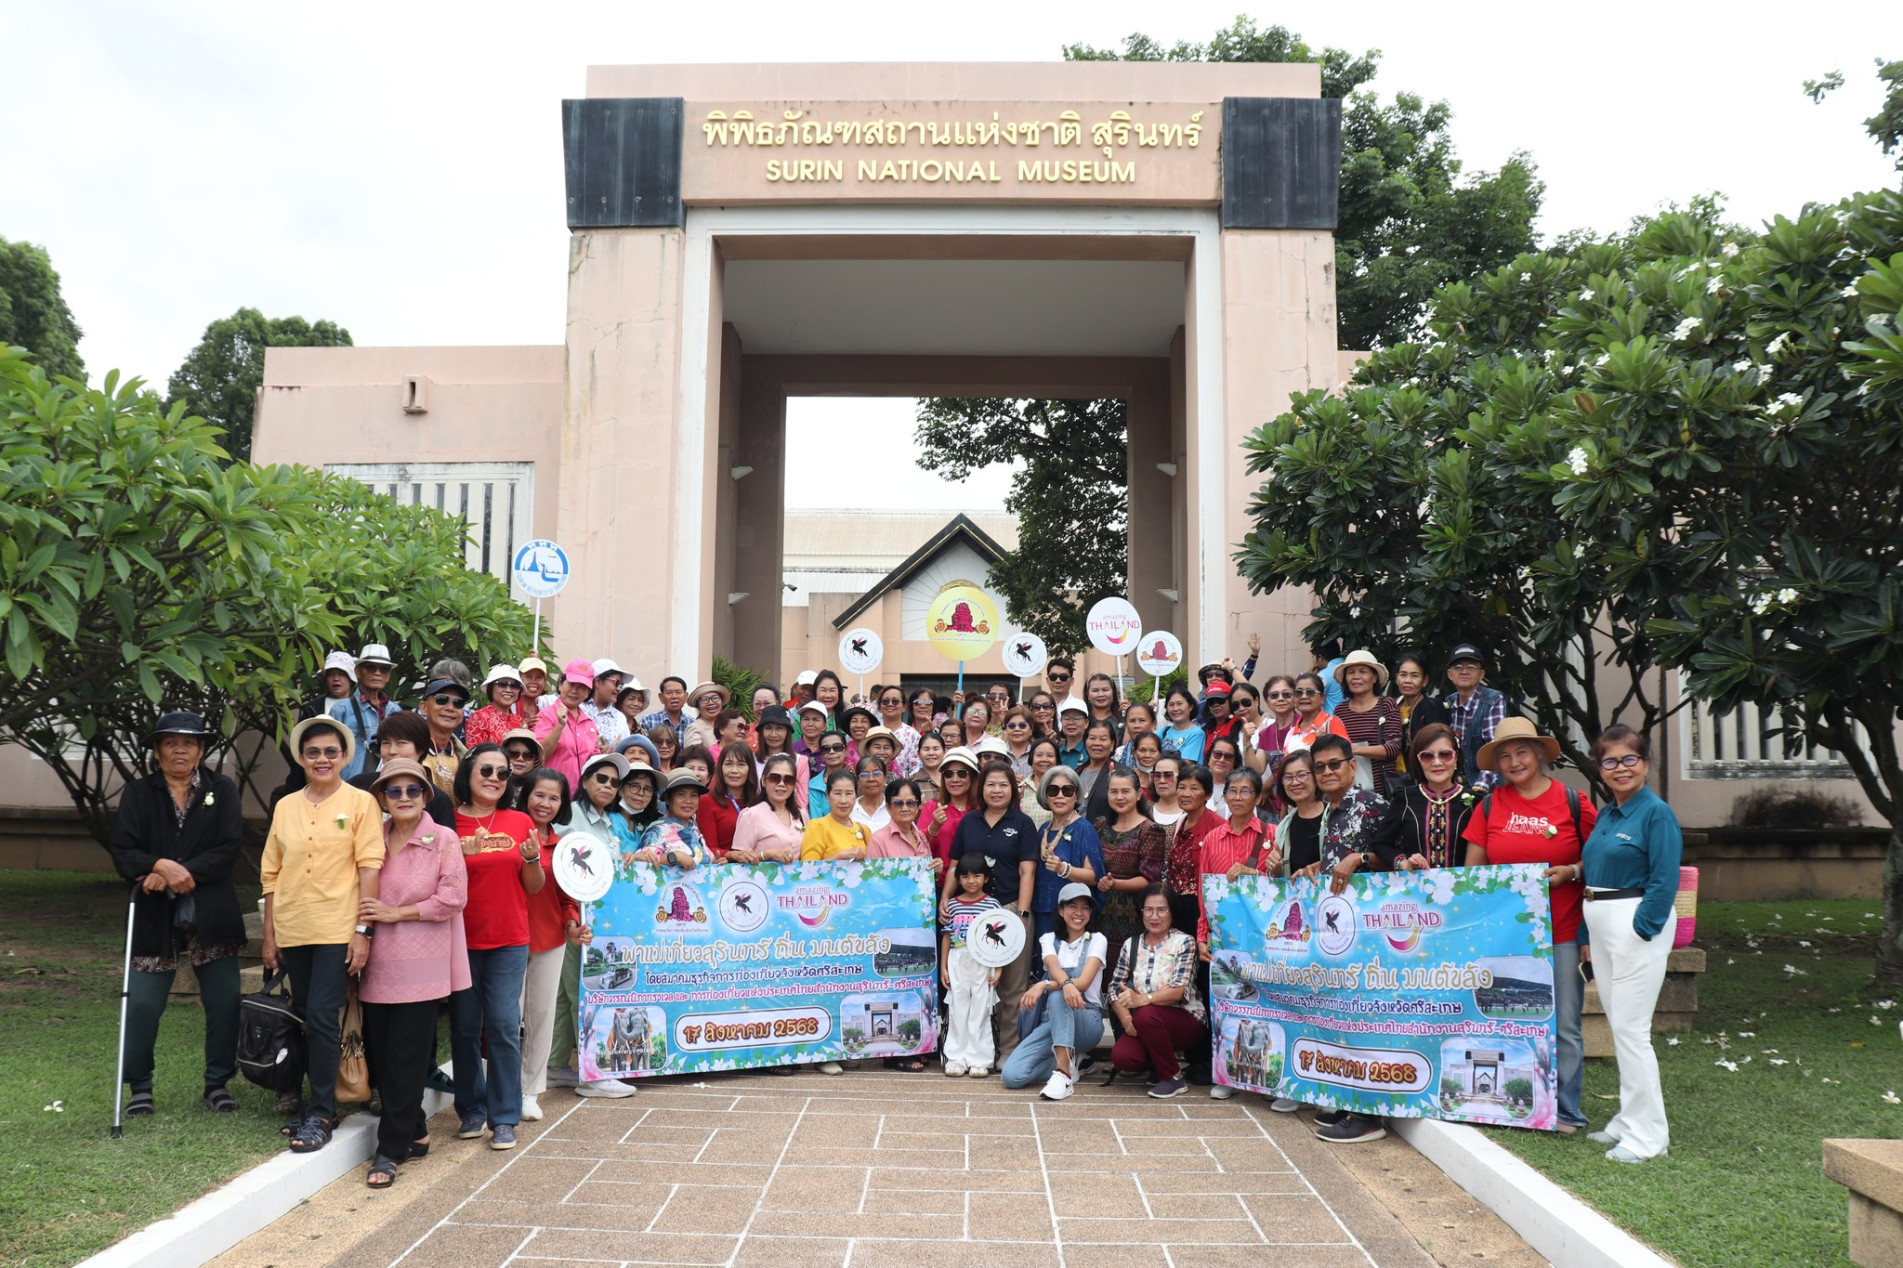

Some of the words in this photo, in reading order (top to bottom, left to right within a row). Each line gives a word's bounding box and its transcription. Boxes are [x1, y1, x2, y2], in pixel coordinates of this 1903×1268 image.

[702, 110, 1081, 147] พิพิธภัณฑสถานแห่งชาติ
[1092, 110, 1203, 158] สุรินทร์
[765, 160, 844, 182] SURIN
[857, 160, 1002, 182] NATIONAL
[1018, 160, 1137, 182] MUSEUM
[1088, 620, 1141, 631] THAILAND
[776, 893, 849, 909] THAILAND
[1362, 912, 1440, 928] THAILAND
[621, 936, 774, 969] พาแม่เที่ยวสุรินทร์
[774, 931, 806, 960] ถิ่น
[811, 932, 892, 957] มนต์ขลัง
[1366, 956, 1398, 989] ถิ่น
[1403, 962, 1494, 989] มนต์ขลัง
[683, 1025, 701, 1044] 17
[704, 1021, 772, 1043] สิงหาคม
[773, 1017, 819, 1037] 2568
[1299, 1050, 1315, 1071] 17
[1315, 1050, 1368, 1080] สิงหาคม
[1369, 1061, 1418, 1083] 2568
